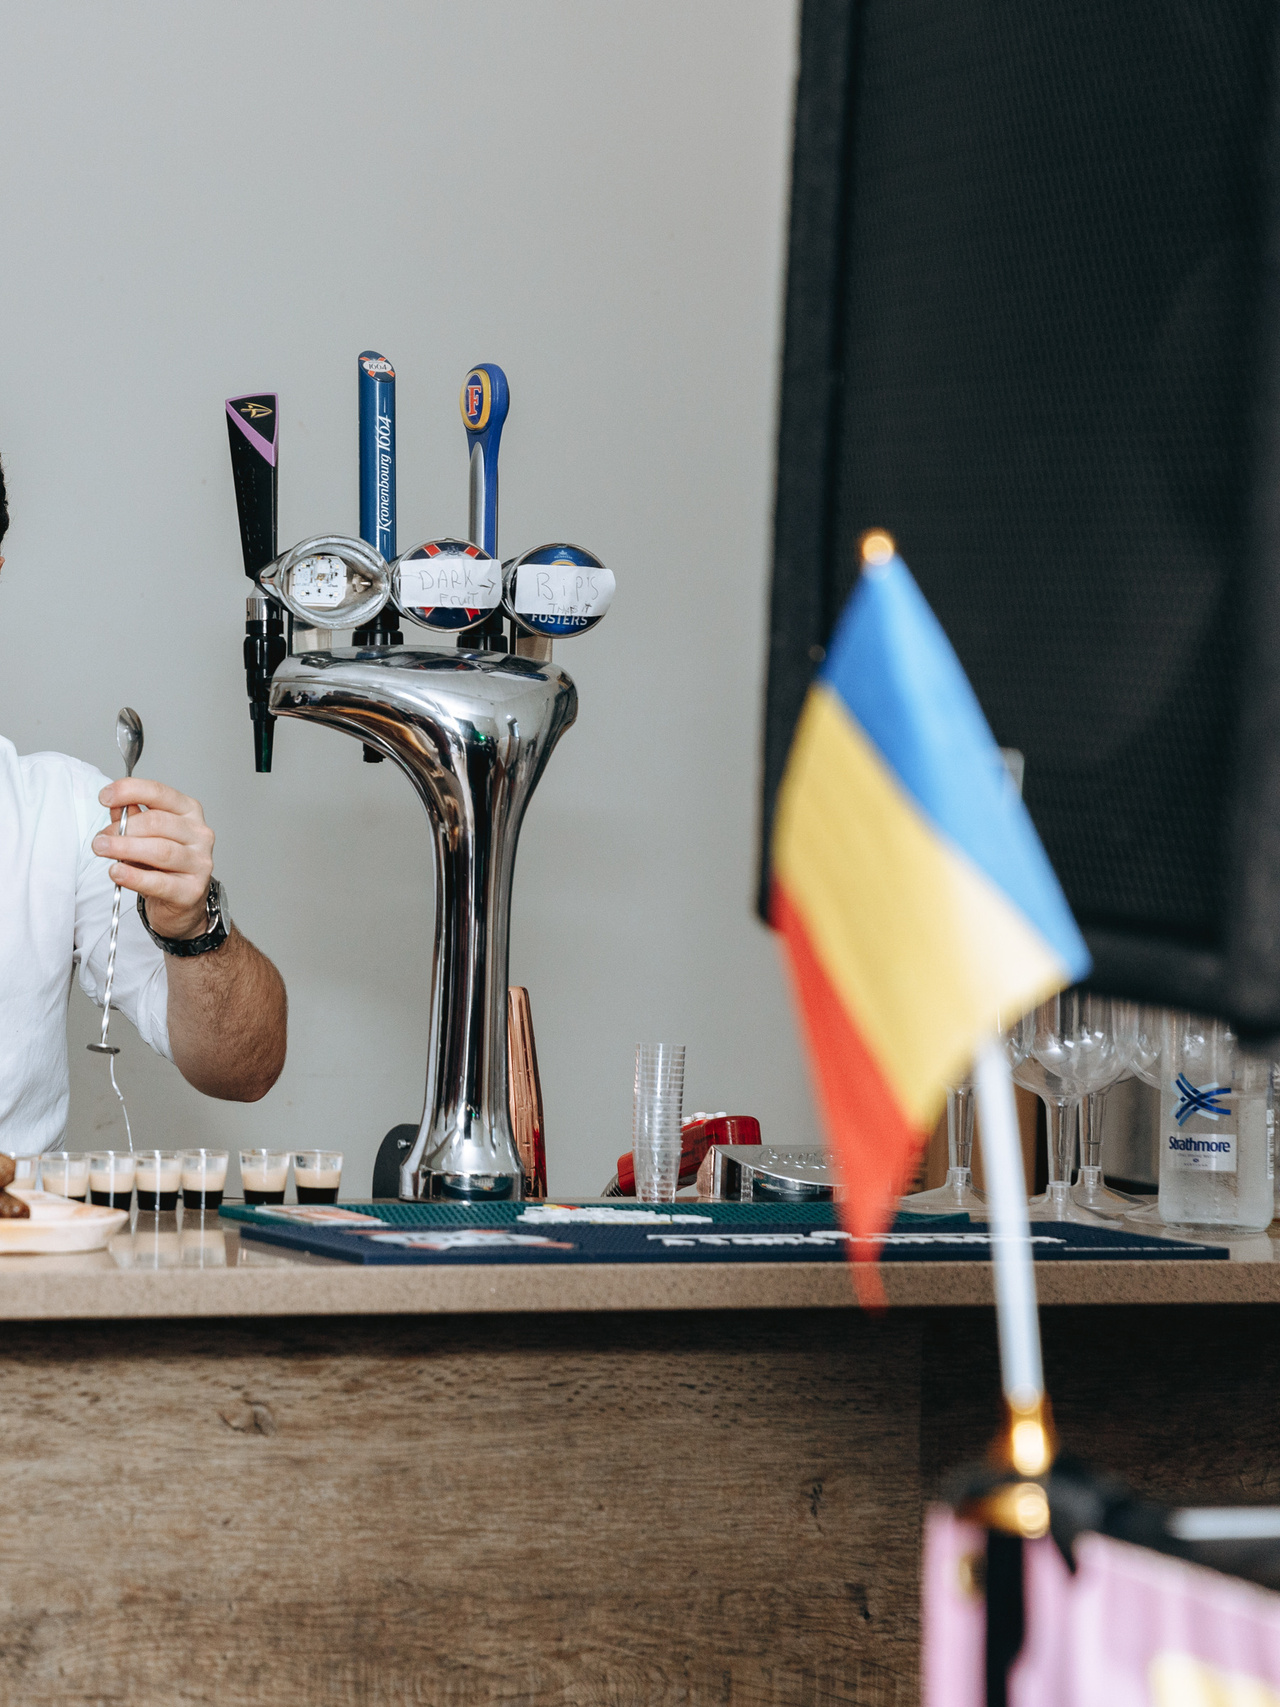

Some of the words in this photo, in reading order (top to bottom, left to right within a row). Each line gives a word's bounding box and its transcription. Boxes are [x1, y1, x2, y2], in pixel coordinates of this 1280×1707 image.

[467, 385, 481, 416] F
[375, 415, 392, 452] 1664
[378, 454, 392, 532] Kronenbourg
[419, 568, 473, 590] DARK
[1169, 1136, 1231, 1153] Strathmore
